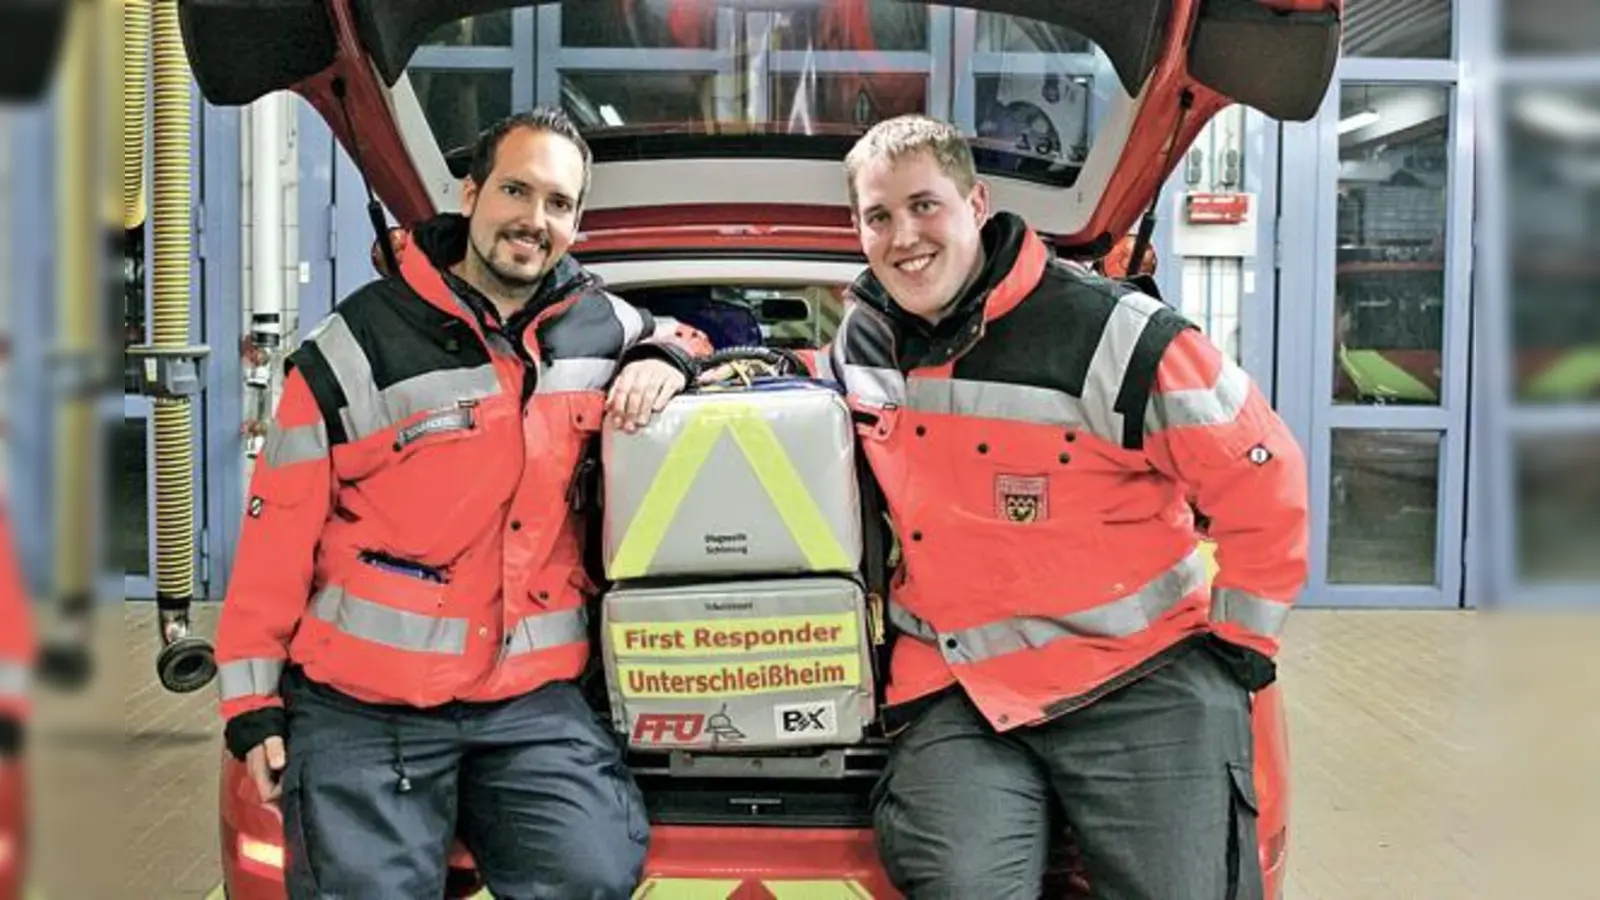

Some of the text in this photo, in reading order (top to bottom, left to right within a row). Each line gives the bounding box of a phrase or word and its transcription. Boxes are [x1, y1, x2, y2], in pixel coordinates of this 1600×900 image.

[625, 623, 842, 650] First Responder
[628, 662, 845, 693] Unterschleißheim
